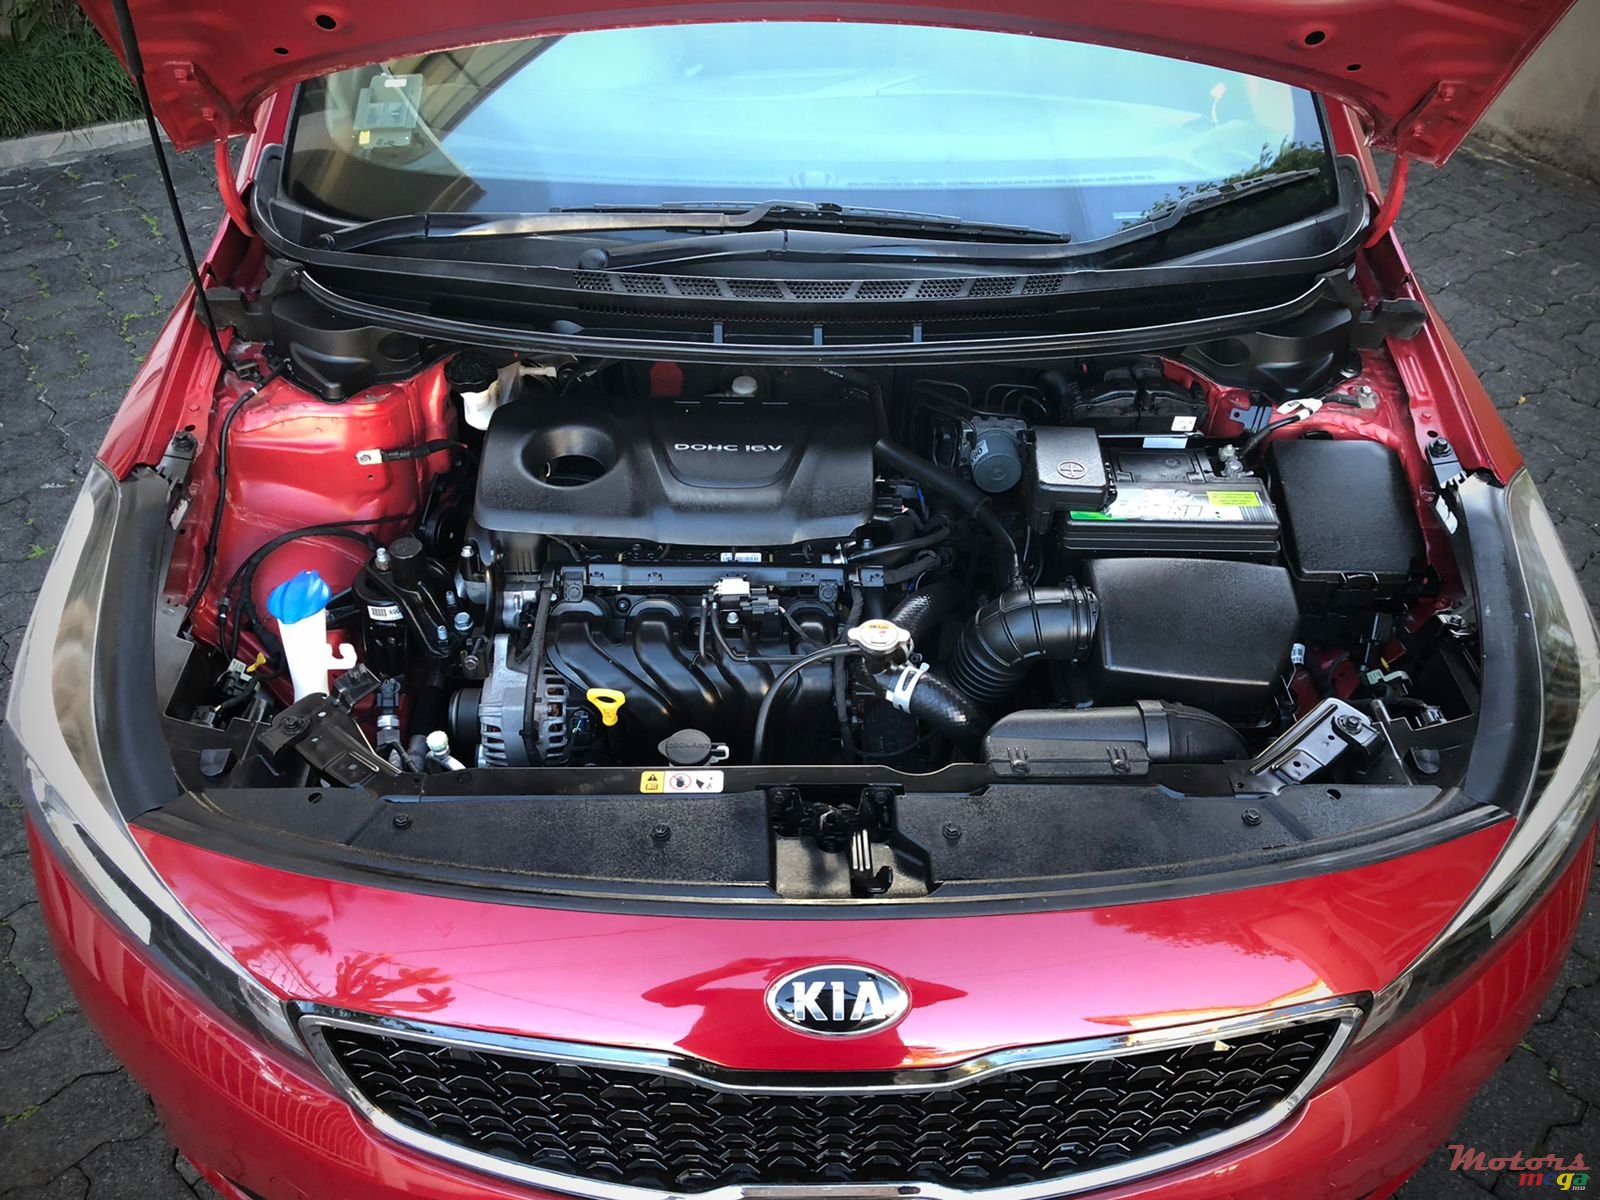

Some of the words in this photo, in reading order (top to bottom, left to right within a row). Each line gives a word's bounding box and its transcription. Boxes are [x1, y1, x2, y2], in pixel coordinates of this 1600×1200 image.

[674, 443, 738, 451] DOHC
[745, 444, 782, 452] 16V
[792, 981, 886, 1021] KIA
